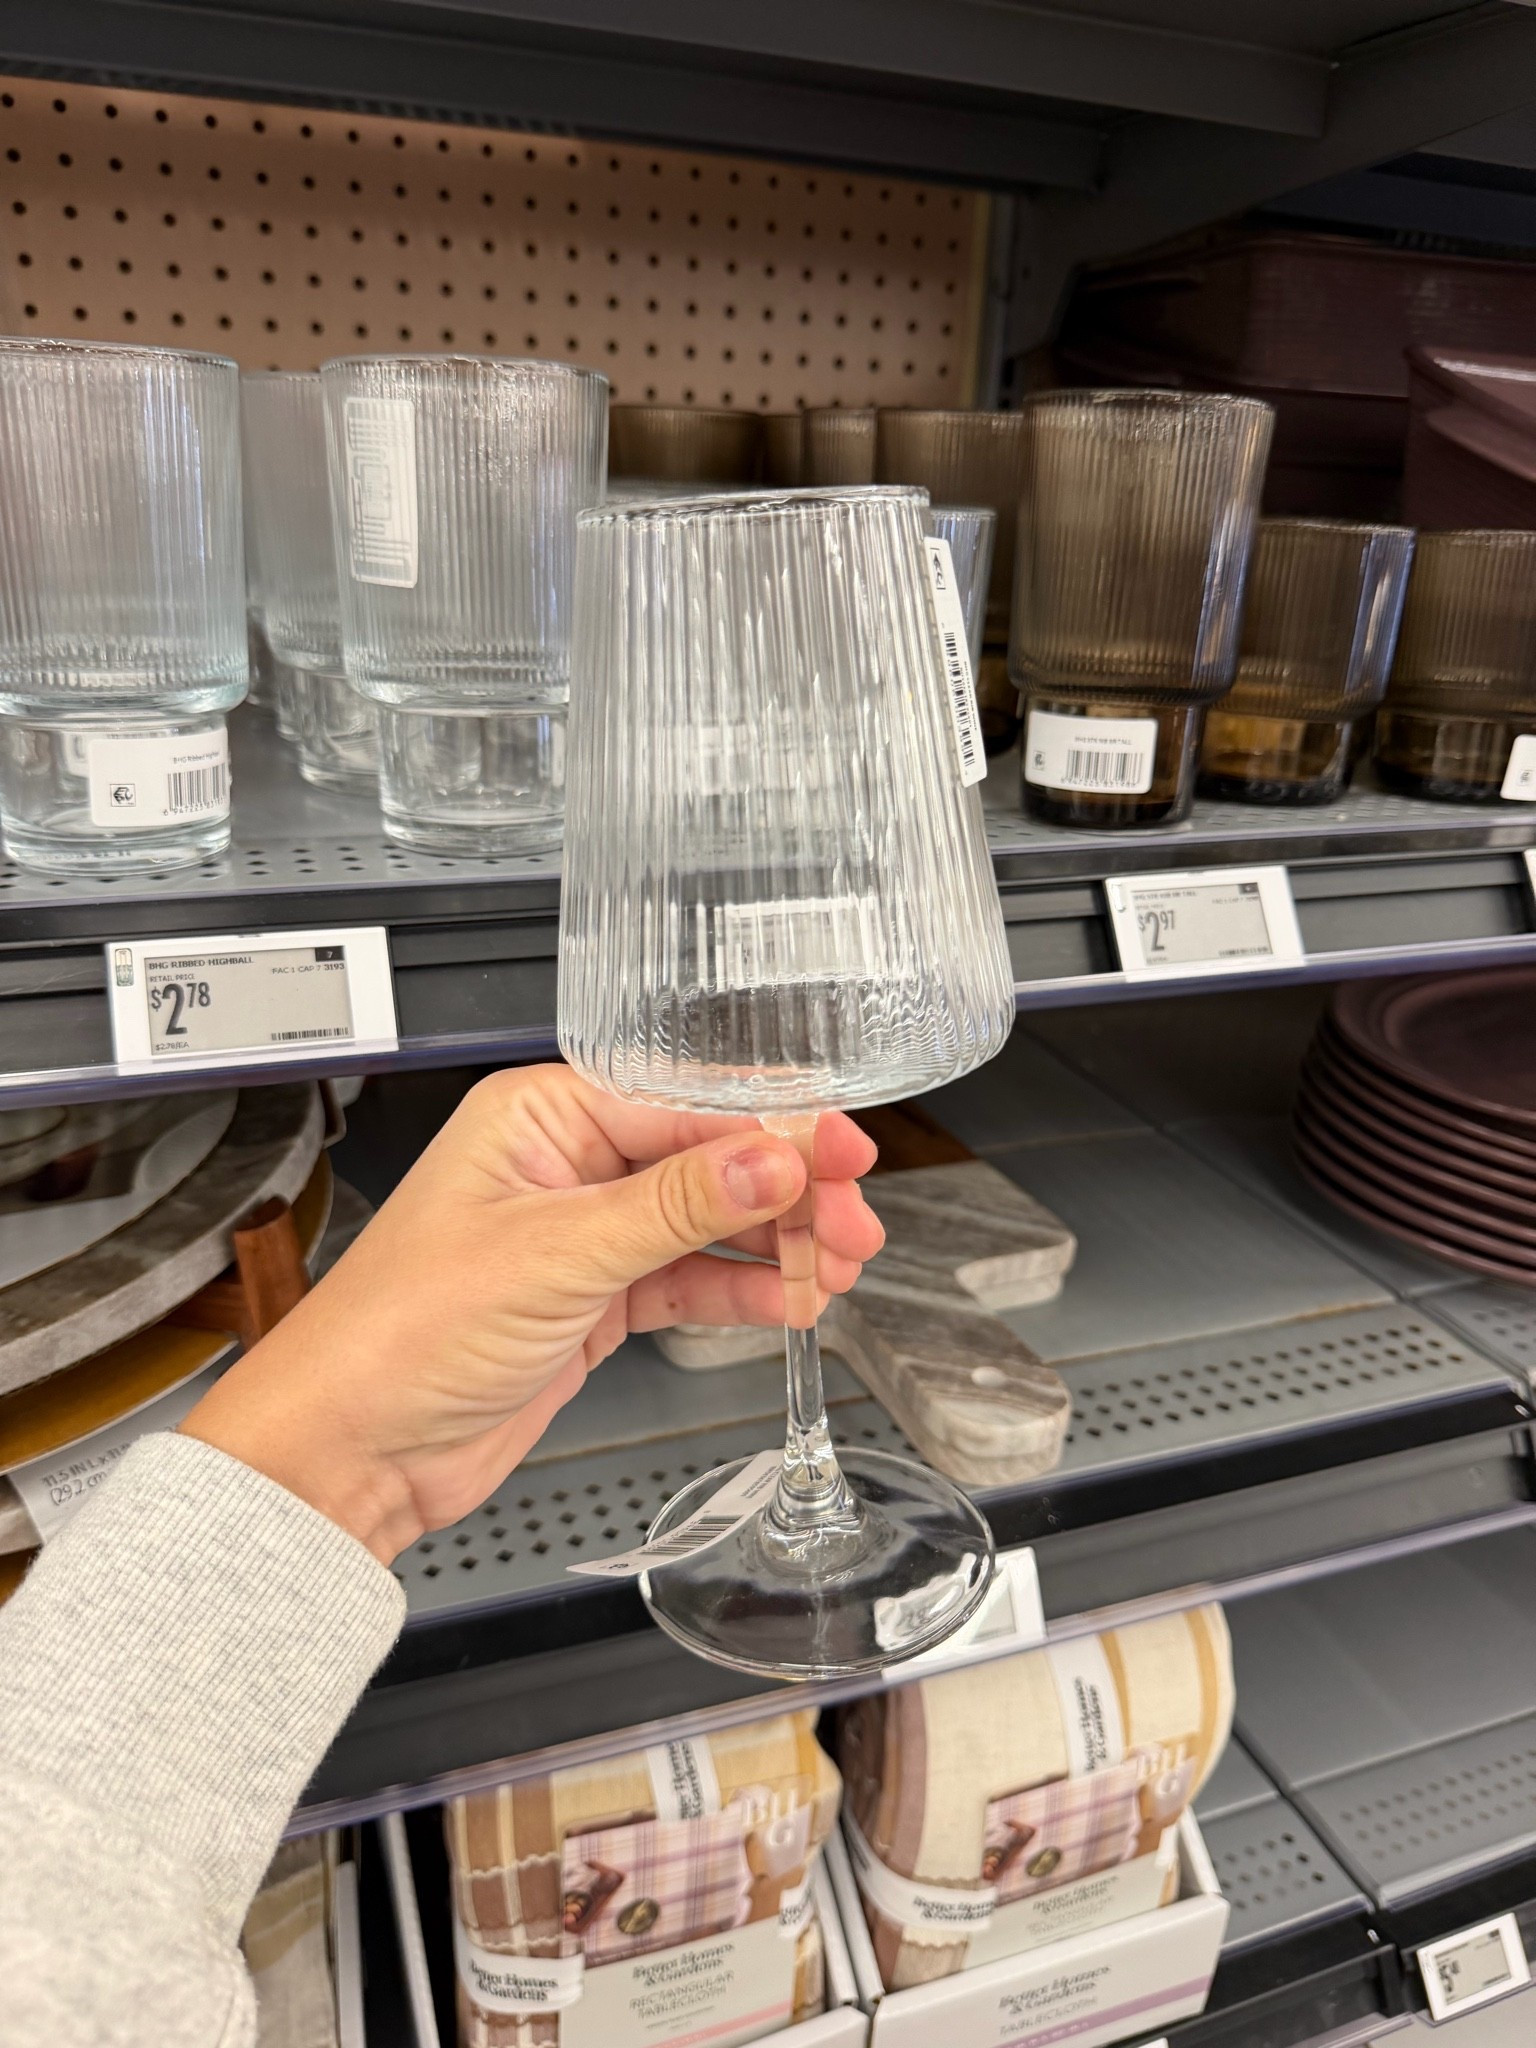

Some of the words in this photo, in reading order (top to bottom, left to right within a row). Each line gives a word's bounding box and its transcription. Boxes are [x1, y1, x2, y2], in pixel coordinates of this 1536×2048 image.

[149, 962, 168, 970] BHG
[171, 960, 205, 969] RIBBED
[208, 956, 254, 966] HIGHBALL
[324, 963, 345, 971] 3193
[175, 973, 196, 981] PRICE
